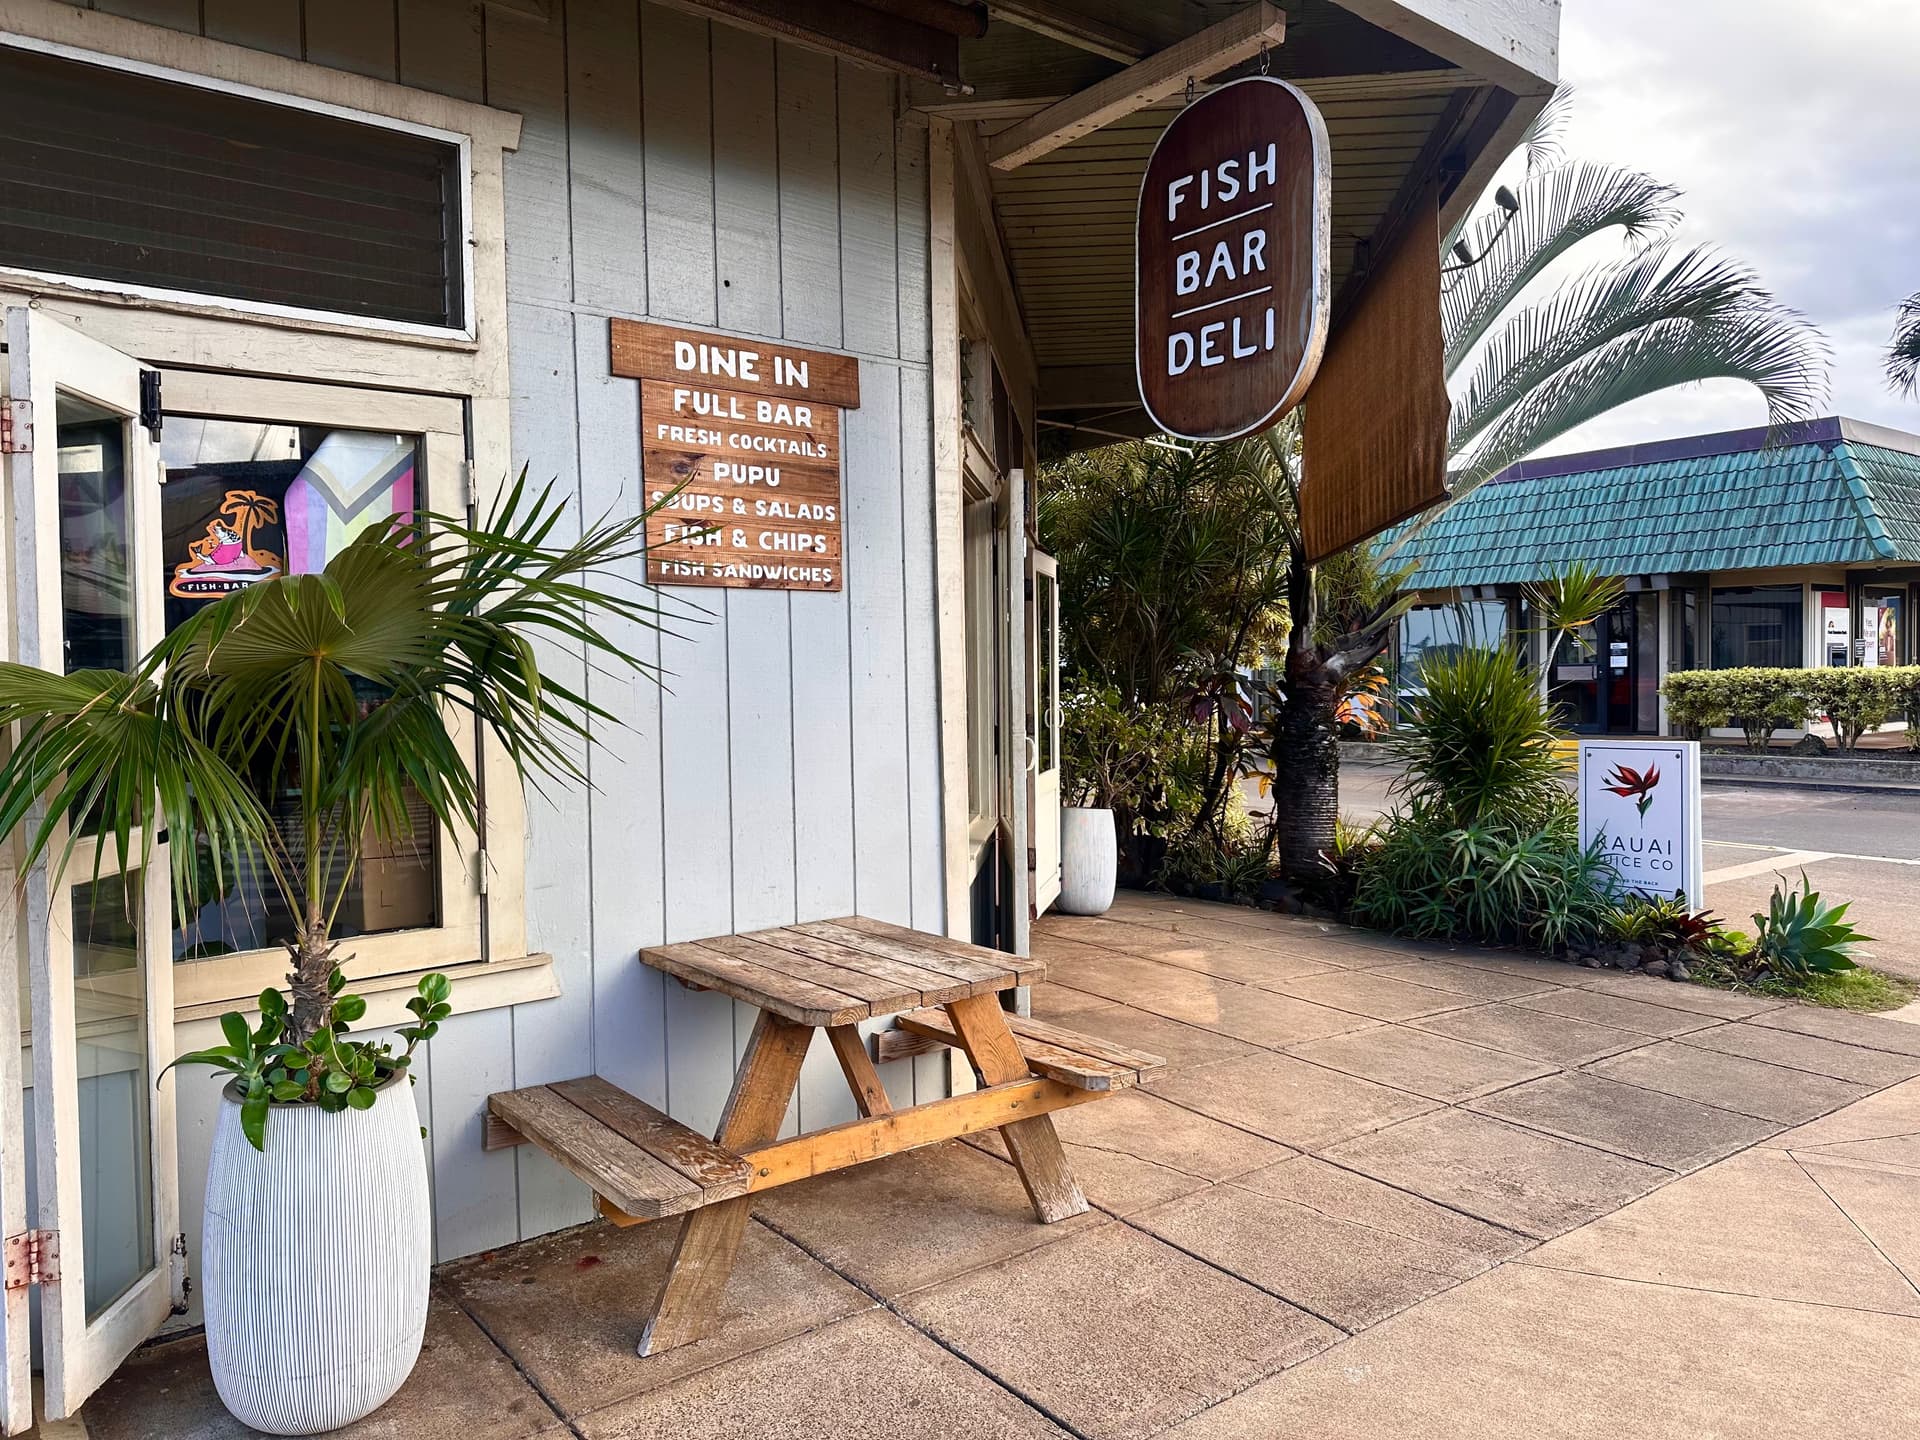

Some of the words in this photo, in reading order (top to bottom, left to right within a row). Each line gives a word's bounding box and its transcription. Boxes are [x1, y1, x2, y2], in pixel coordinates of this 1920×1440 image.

[1168, 143, 1276, 222] FISH
[1176, 229, 1266, 296] BAR
[1168, 308, 1275, 376] DELI
[674, 340, 760, 382] DINE
[774, 356, 809, 389] IN
[674, 389, 746, 420] FULL
[757, 400, 812, 428] BAR
[657, 424, 722, 446] FRESH
[728, 434, 827, 458] COCKTAILS
[714, 462, 780, 487] PUPU
[732, 498, 747, 515] &
[755, 500, 836, 521] SALADS
[664, 524, 722, 546] FISH
[732, 528, 748, 548] &
[759, 532, 827, 553] CHIPS
[661, 560, 705, 577] FISH
[712, 563, 831, 583] SANDWICHES
[1650, 858, 1673, 871] CO
